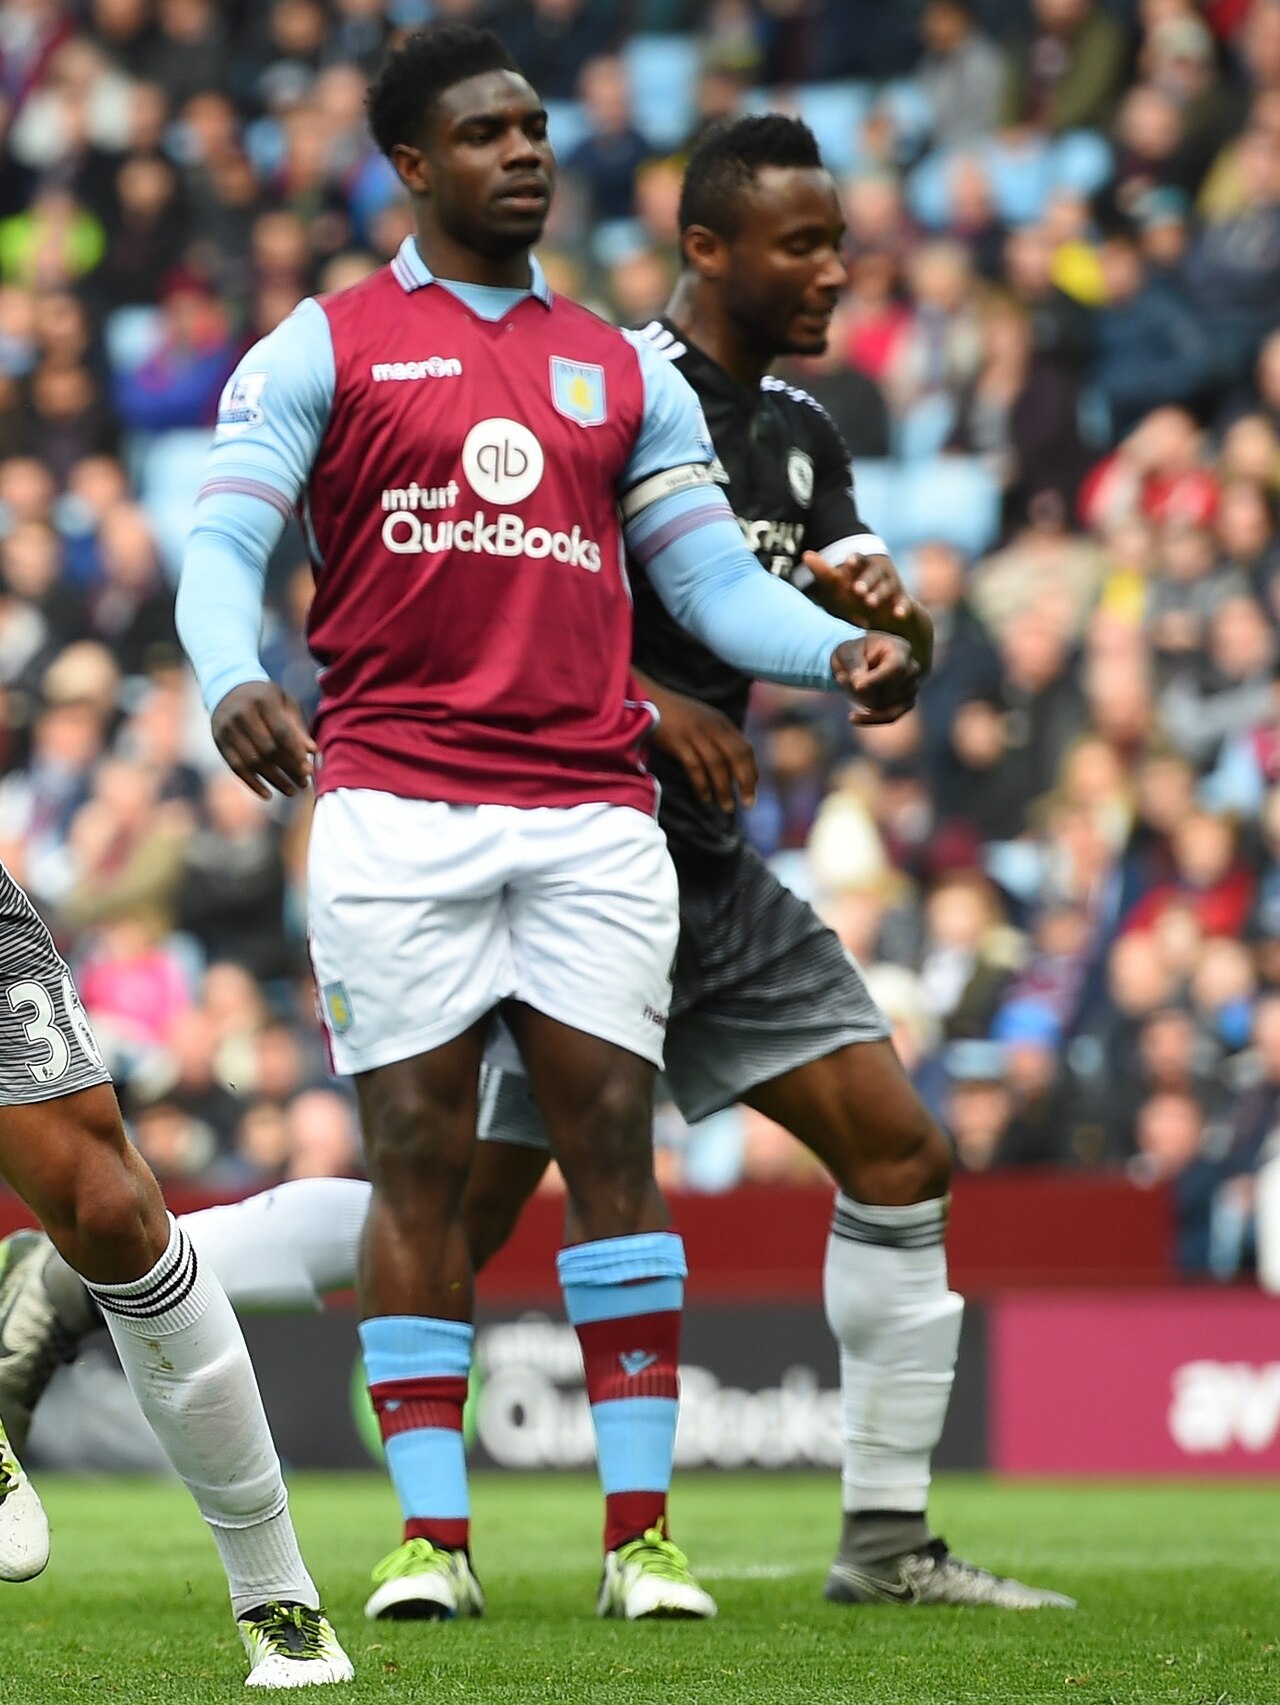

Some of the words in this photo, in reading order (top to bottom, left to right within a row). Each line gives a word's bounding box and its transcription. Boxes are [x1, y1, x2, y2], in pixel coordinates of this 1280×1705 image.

[371, 356, 462, 381] macron
[381, 480, 459, 511] intuit
[382, 511, 602, 573] QuickBooks
[6, 972, 104, 1085] 36
